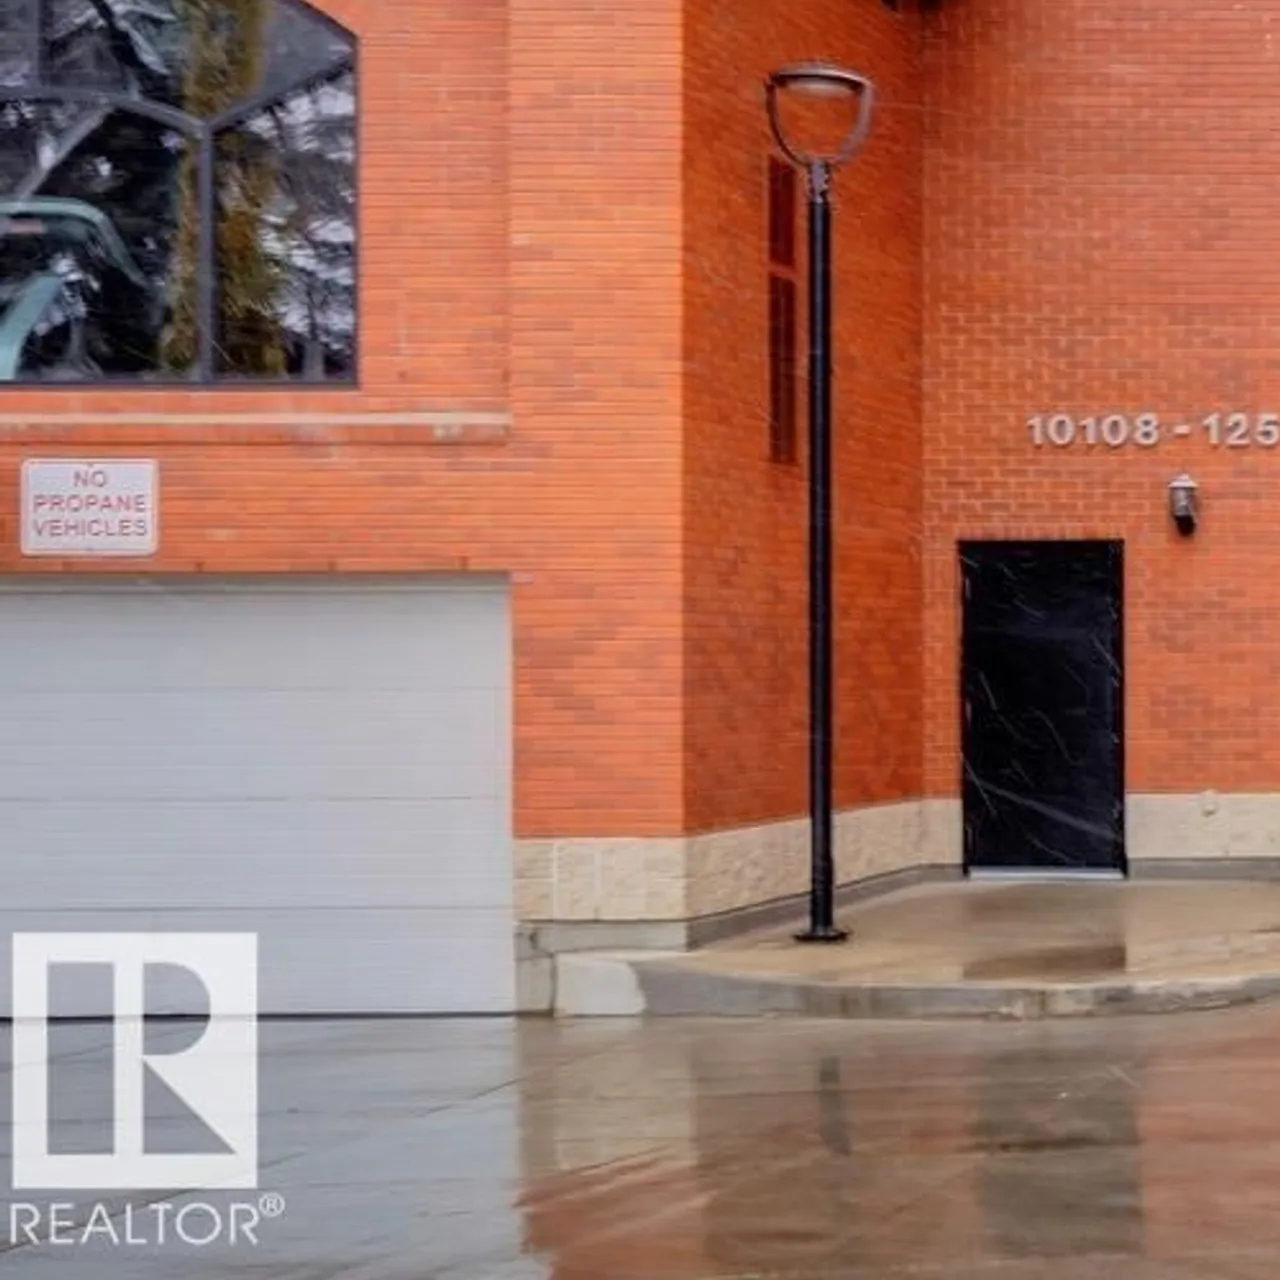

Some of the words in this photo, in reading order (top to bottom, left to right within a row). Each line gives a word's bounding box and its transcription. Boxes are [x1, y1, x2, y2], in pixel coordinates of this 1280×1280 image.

[1026, 412, 1160, 446] 10108
[1202, 412, 1280, 446] 125
[73, 470, 108, 487] NO
[33, 494, 147, 513] PROPANE
[33, 519, 148, 537] VEHICLES
